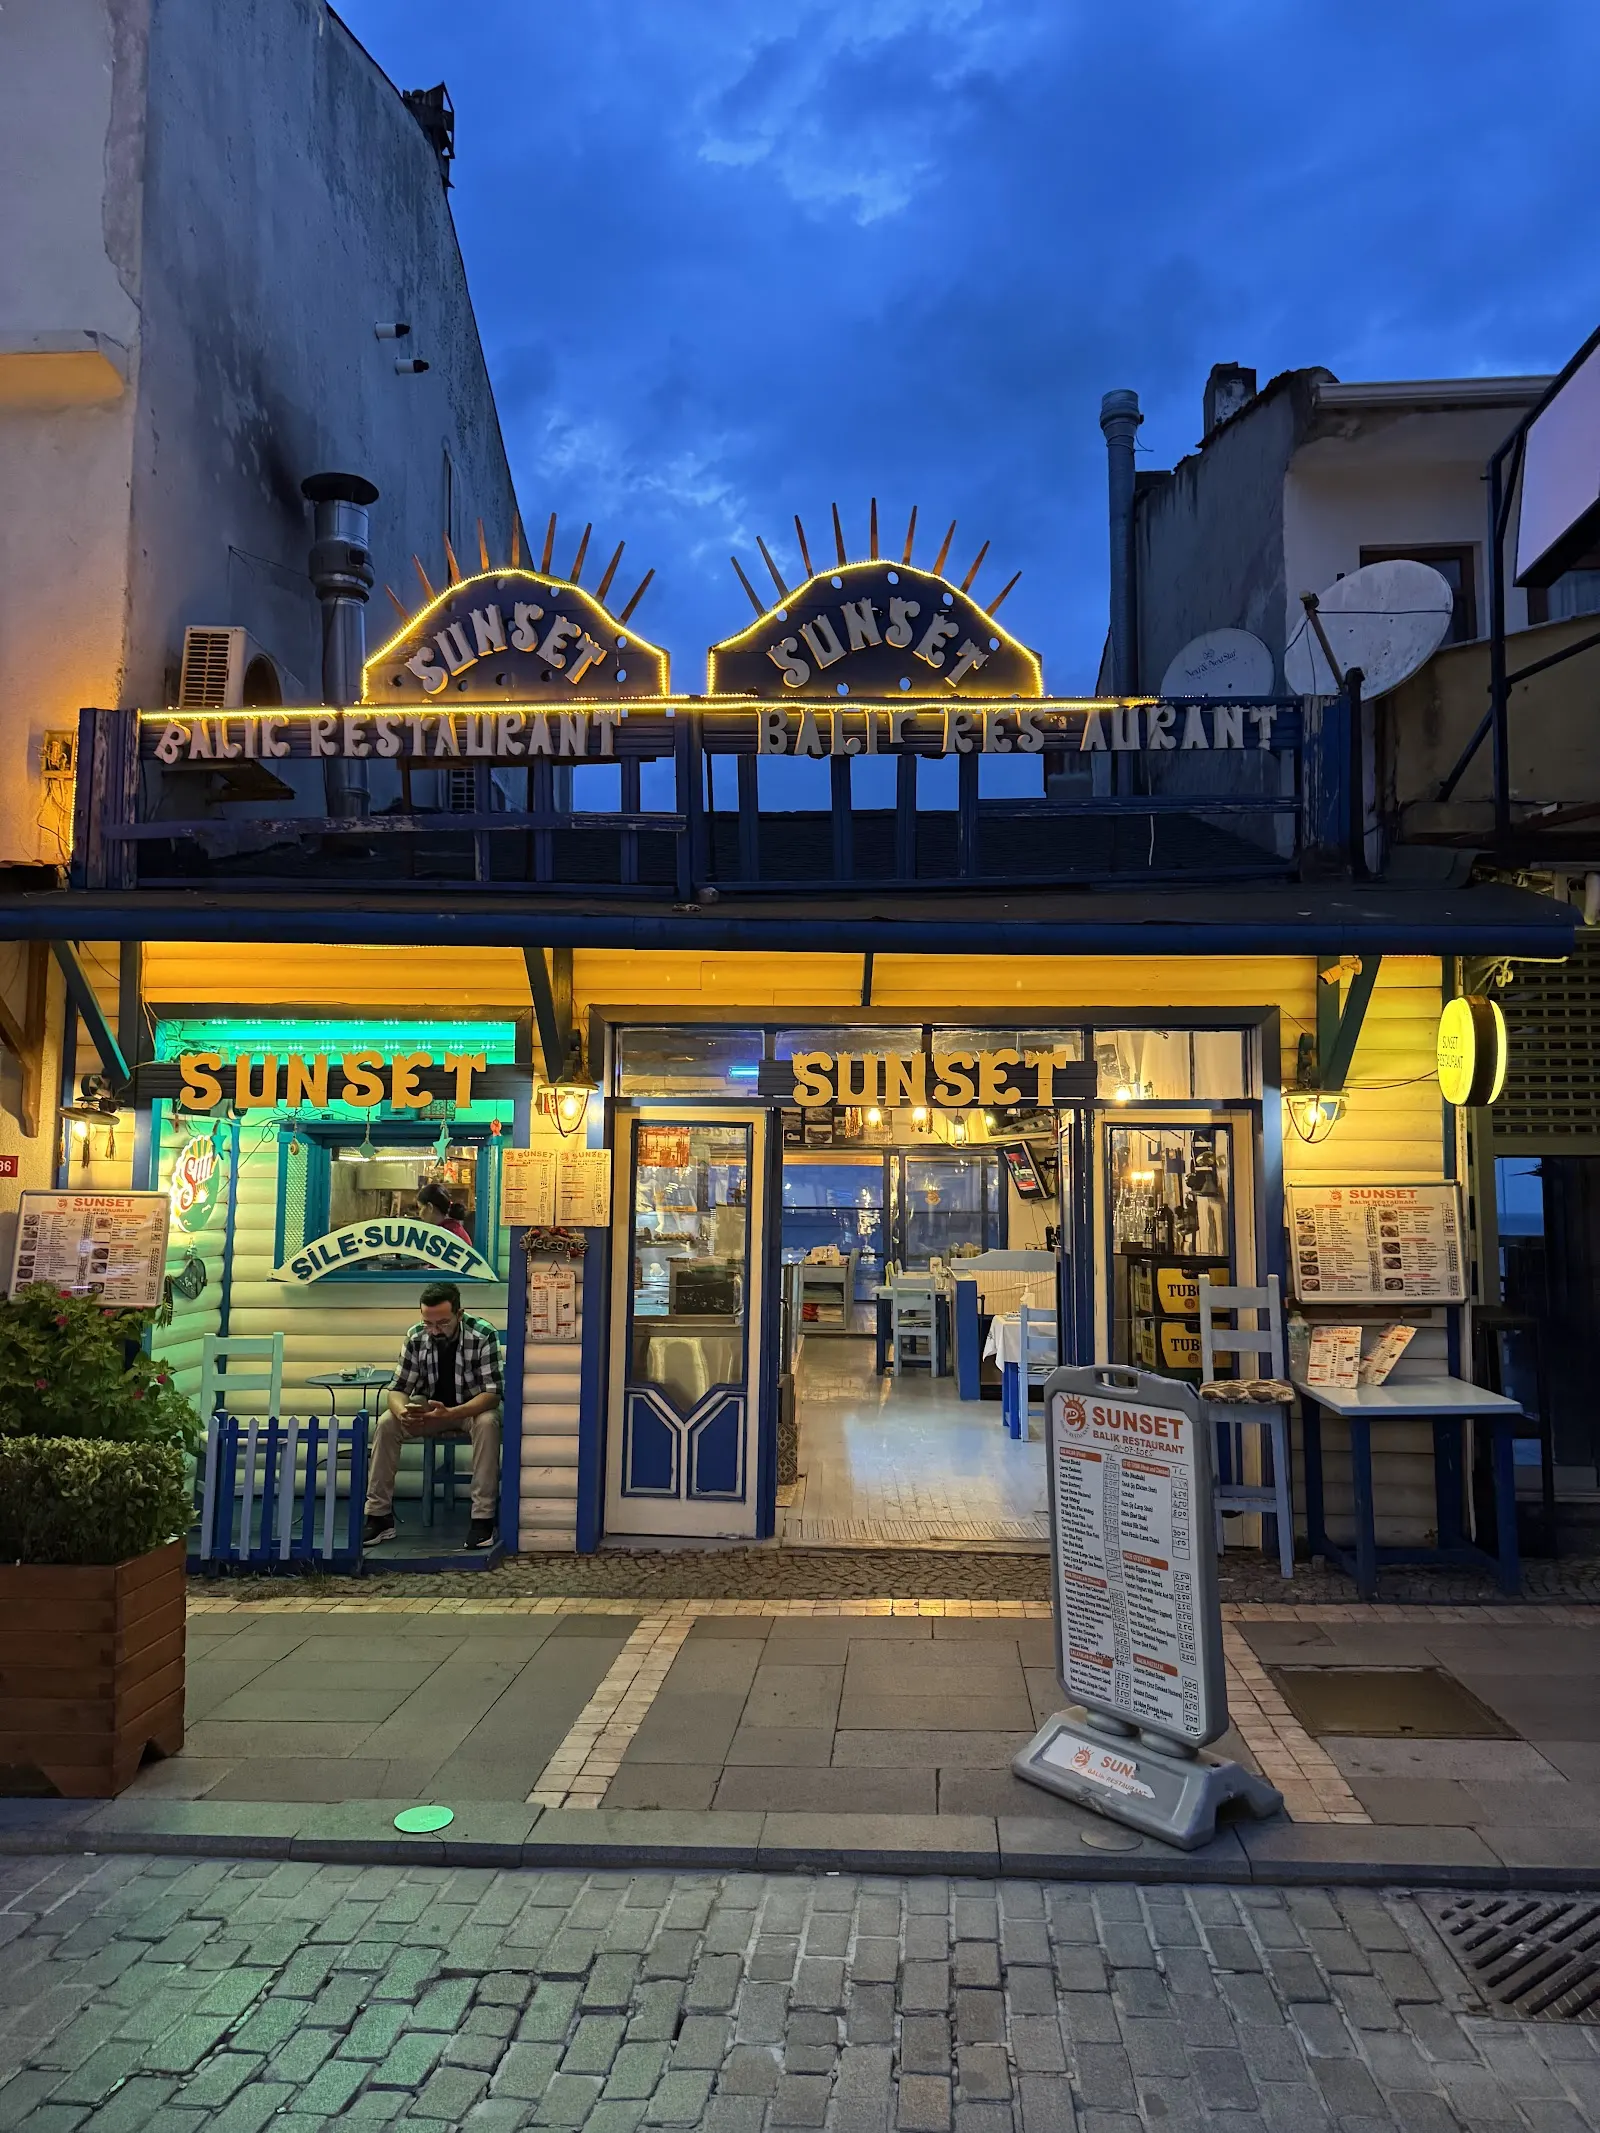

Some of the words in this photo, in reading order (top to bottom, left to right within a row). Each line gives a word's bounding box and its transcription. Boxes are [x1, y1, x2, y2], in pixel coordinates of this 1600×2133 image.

[405, 601, 607, 694] SUNSET
[766, 596, 989, 688] SUNSET
[153, 716, 291, 764] BALIK
[310, 710, 621, 757] RESTAURANT
[179, 1051, 487, 1110] SUNSET
[791, 1049, 1067, 1107] SUNSET
[74, 1197, 134, 1207] SUNSET
[1349, 1189, 1418, 1198] SUNSET
[1167, 1284, 1200, 1297] TUB
[1171, 1338, 1202, 1351] TUB
[1092, 1406, 1184, 1439] SUNSET
[1093, 1430, 1120, 1443] BALIK
[1122, 1436, 1184, 1454] RESTAURANT
[1171, 1465, 1186, 1475] TL
